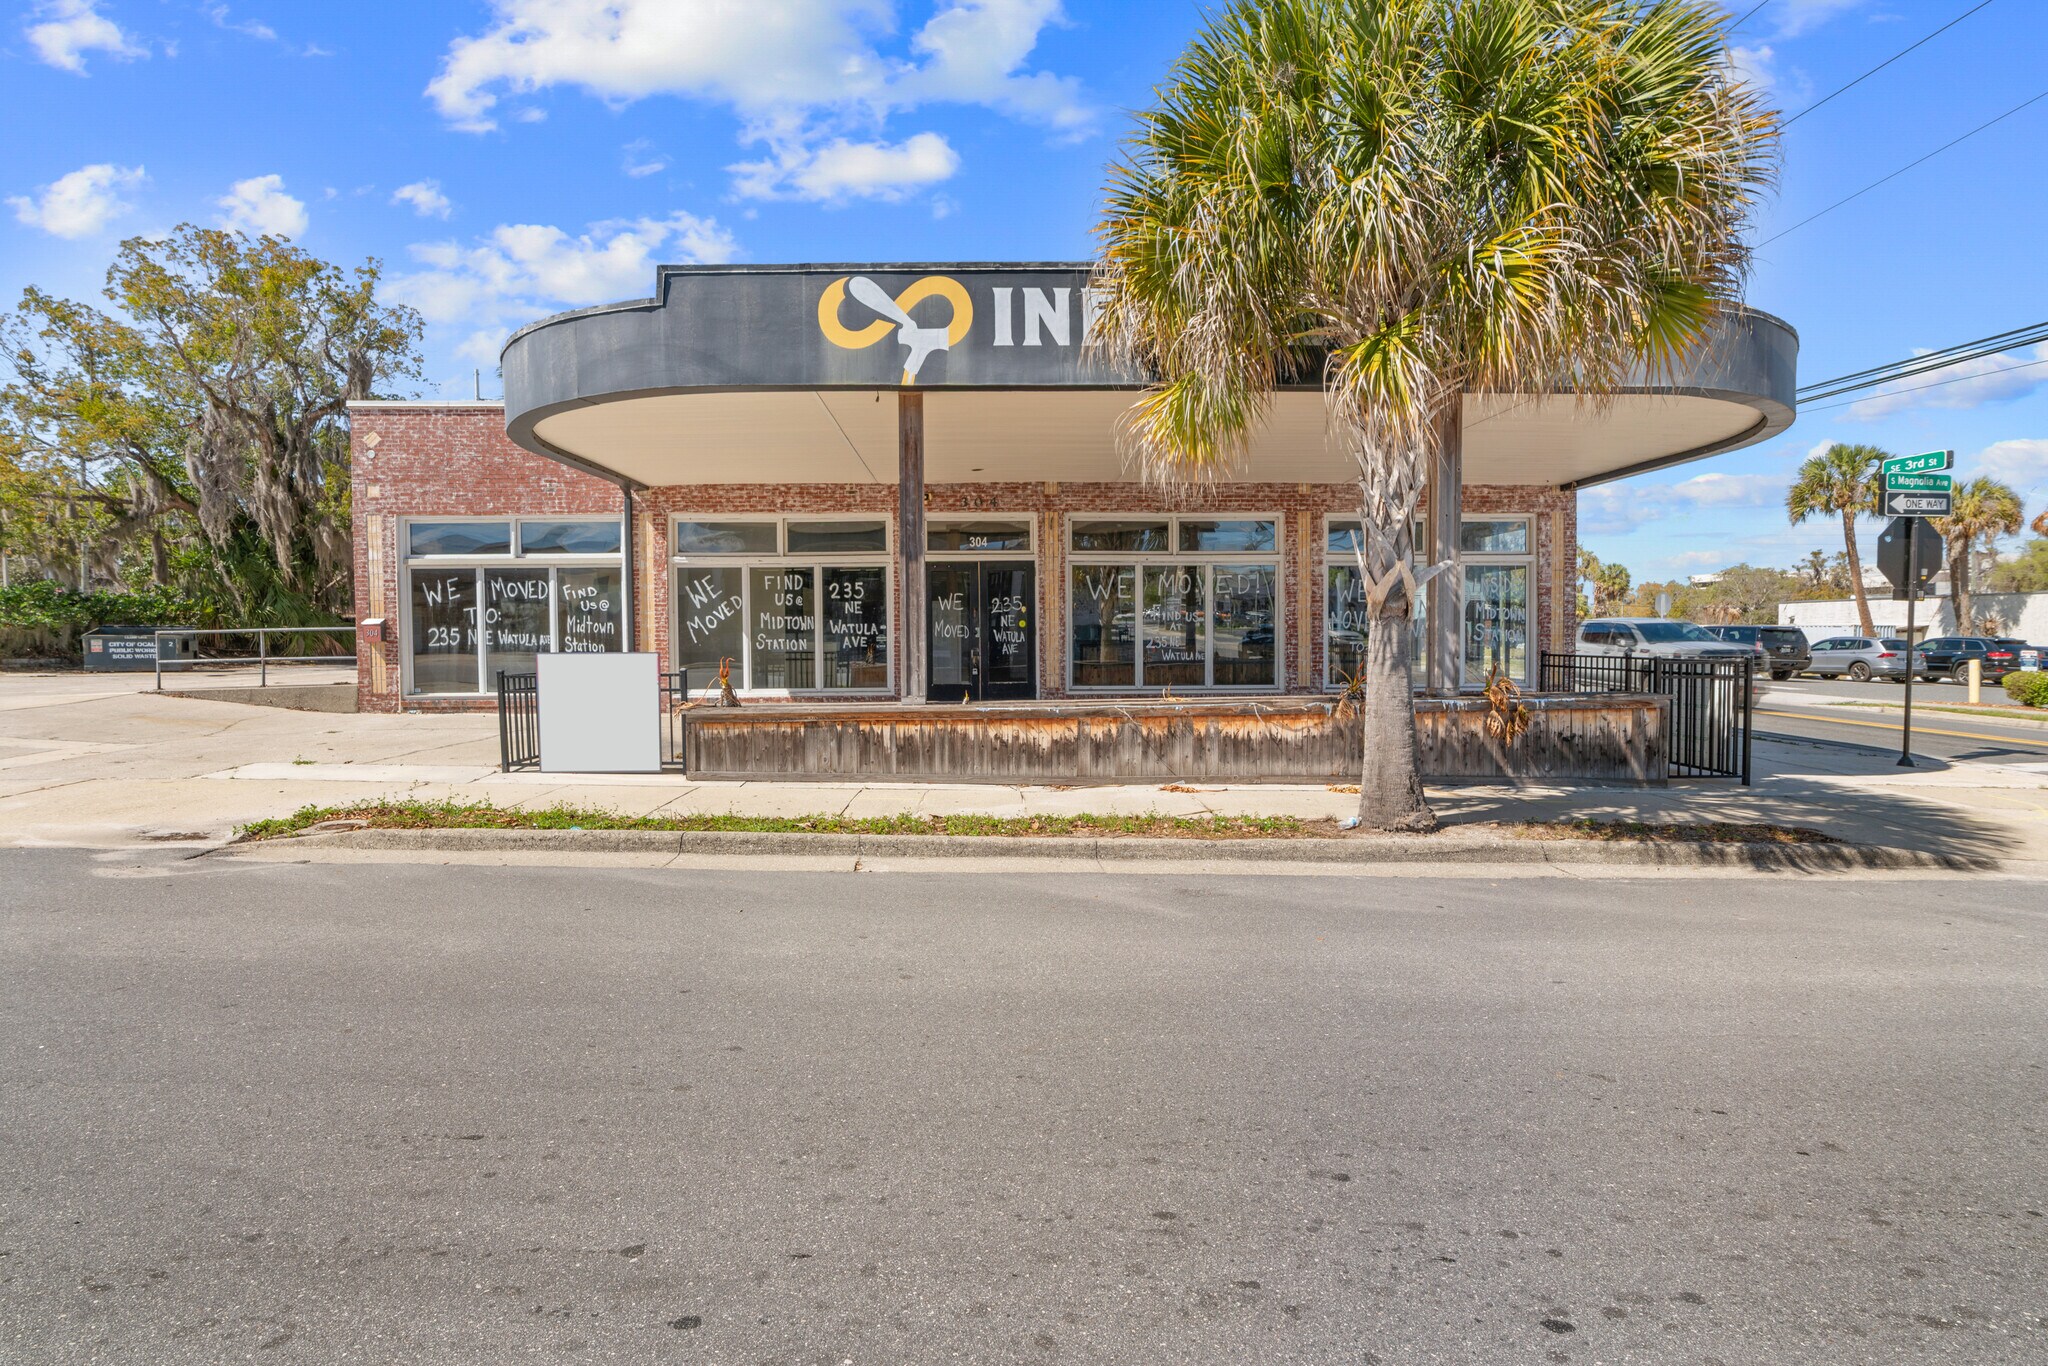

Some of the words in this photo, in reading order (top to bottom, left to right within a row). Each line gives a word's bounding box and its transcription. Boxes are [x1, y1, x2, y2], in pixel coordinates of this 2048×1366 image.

[1890, 464, 1901, 473] SE
[1904, 458, 1925, 471] 3rd
[1928, 458, 1938, 467] St
[1890, 477, 1896, 485] S
[1897, 475, 1934, 488] Magnolia
[1936, 479, 1949, 487] Ave
[1905, 499, 1923, 509] ONE
[1926, 499, 1945, 509] WAY
[969, 536, 988, 547] 304
[764, 575, 803, 591] FIND
[829, 582, 864, 599] 235
[1085, 574, 1134, 600] WE
[422, 577, 461, 607] WE
[491, 577, 549, 600] MOVED
[685, 574, 722, 609] WE
[845, 601, 863, 614] NE
[938, 592, 964, 611] WE
[991, 595, 1023, 614] 235
[567, 615, 615, 634] Midtown
[686, 595, 742, 644] MOVED
[760, 612, 814, 631] MIDTOWN
[1000, 614, 1016, 627] NE
[1186, 611, 1200, 623] US
[829, 619, 879, 635] WATULA
[934, 619, 970, 639] MOVED
[1170, 622, 1182, 631] AT
[428, 628, 460, 646] 235
[498, 629, 537, 646] WATULA
[756, 633, 807, 650] STATION
[842, 636, 868, 649] AVE
[993, 629, 1025, 643] WATULA
[564, 636, 605, 653] Station
[1002, 643, 1019, 655] AVE
[1161, 649, 1194, 661] WATULA
